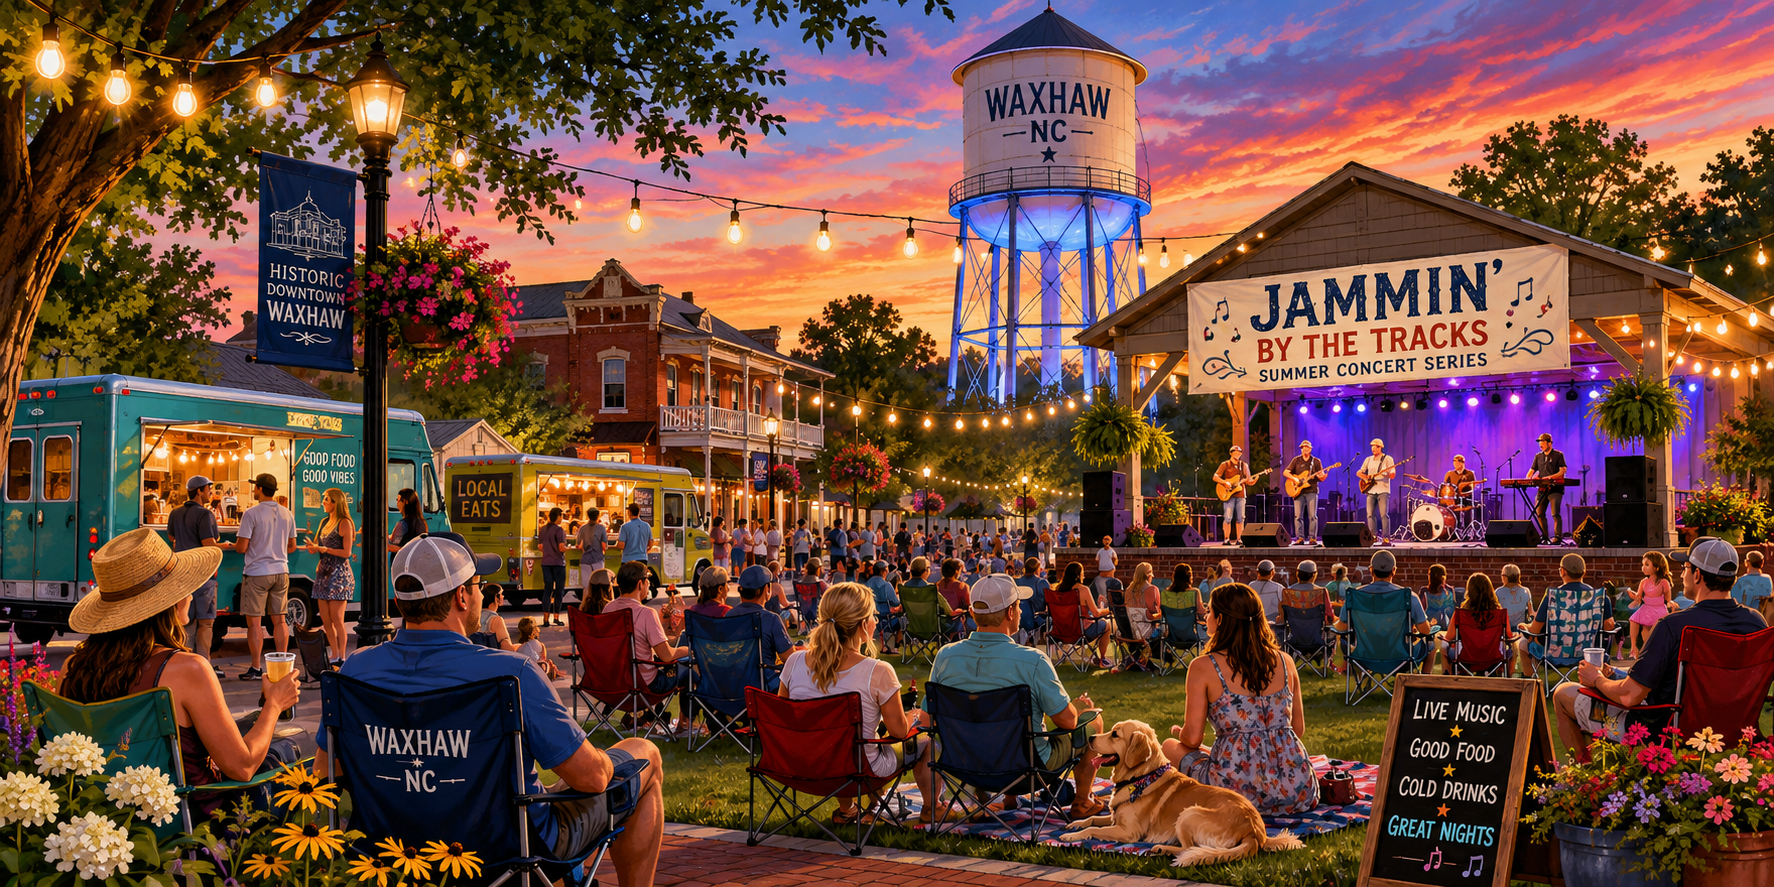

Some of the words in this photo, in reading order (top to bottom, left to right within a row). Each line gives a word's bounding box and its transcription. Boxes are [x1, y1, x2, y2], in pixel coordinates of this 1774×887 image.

[985, 81, 1111, 122] WAXHAW
[1031, 119, 1067, 143] NC
[269, 262, 345, 289] HISTORIC
[267, 282, 346, 306] DOWNTOWN
[1250, 258, 1503, 332] JAMMIN'
[266, 299, 346, 330] WAXHAW
[1257, 336, 1293, 364] BY
[1302, 330, 1358, 360] THE
[1370, 319, 1489, 354] TRACKS
[1259, 364, 1329, 383] SUMMER
[1336, 357, 1417, 377] CONCERT
[1424, 352, 1488, 371] SERIES
[331, 453, 356, 468] FOOD
[302, 469, 328, 483] GOOD
[330, 470, 355, 485] VIBES
[457, 479, 507, 497] LOCAL
[461, 499, 501, 518] EATS
[1412, 698, 1450, 721] LIVE
[1454, 700, 1507, 725] MUSIC
[364, 723, 472, 759] WAXHAW
[1409, 737, 1451, 760] GOOD
[1455, 741, 1496, 764] FOOD
[404, 768, 437, 793] NC
[1399, 775, 1438, 798] COLD
[1441, 780, 1499, 805] DRINKS
[1387, 814, 1437, 840] GREAT
[1439, 820, 1495, 847] NIGHTS
